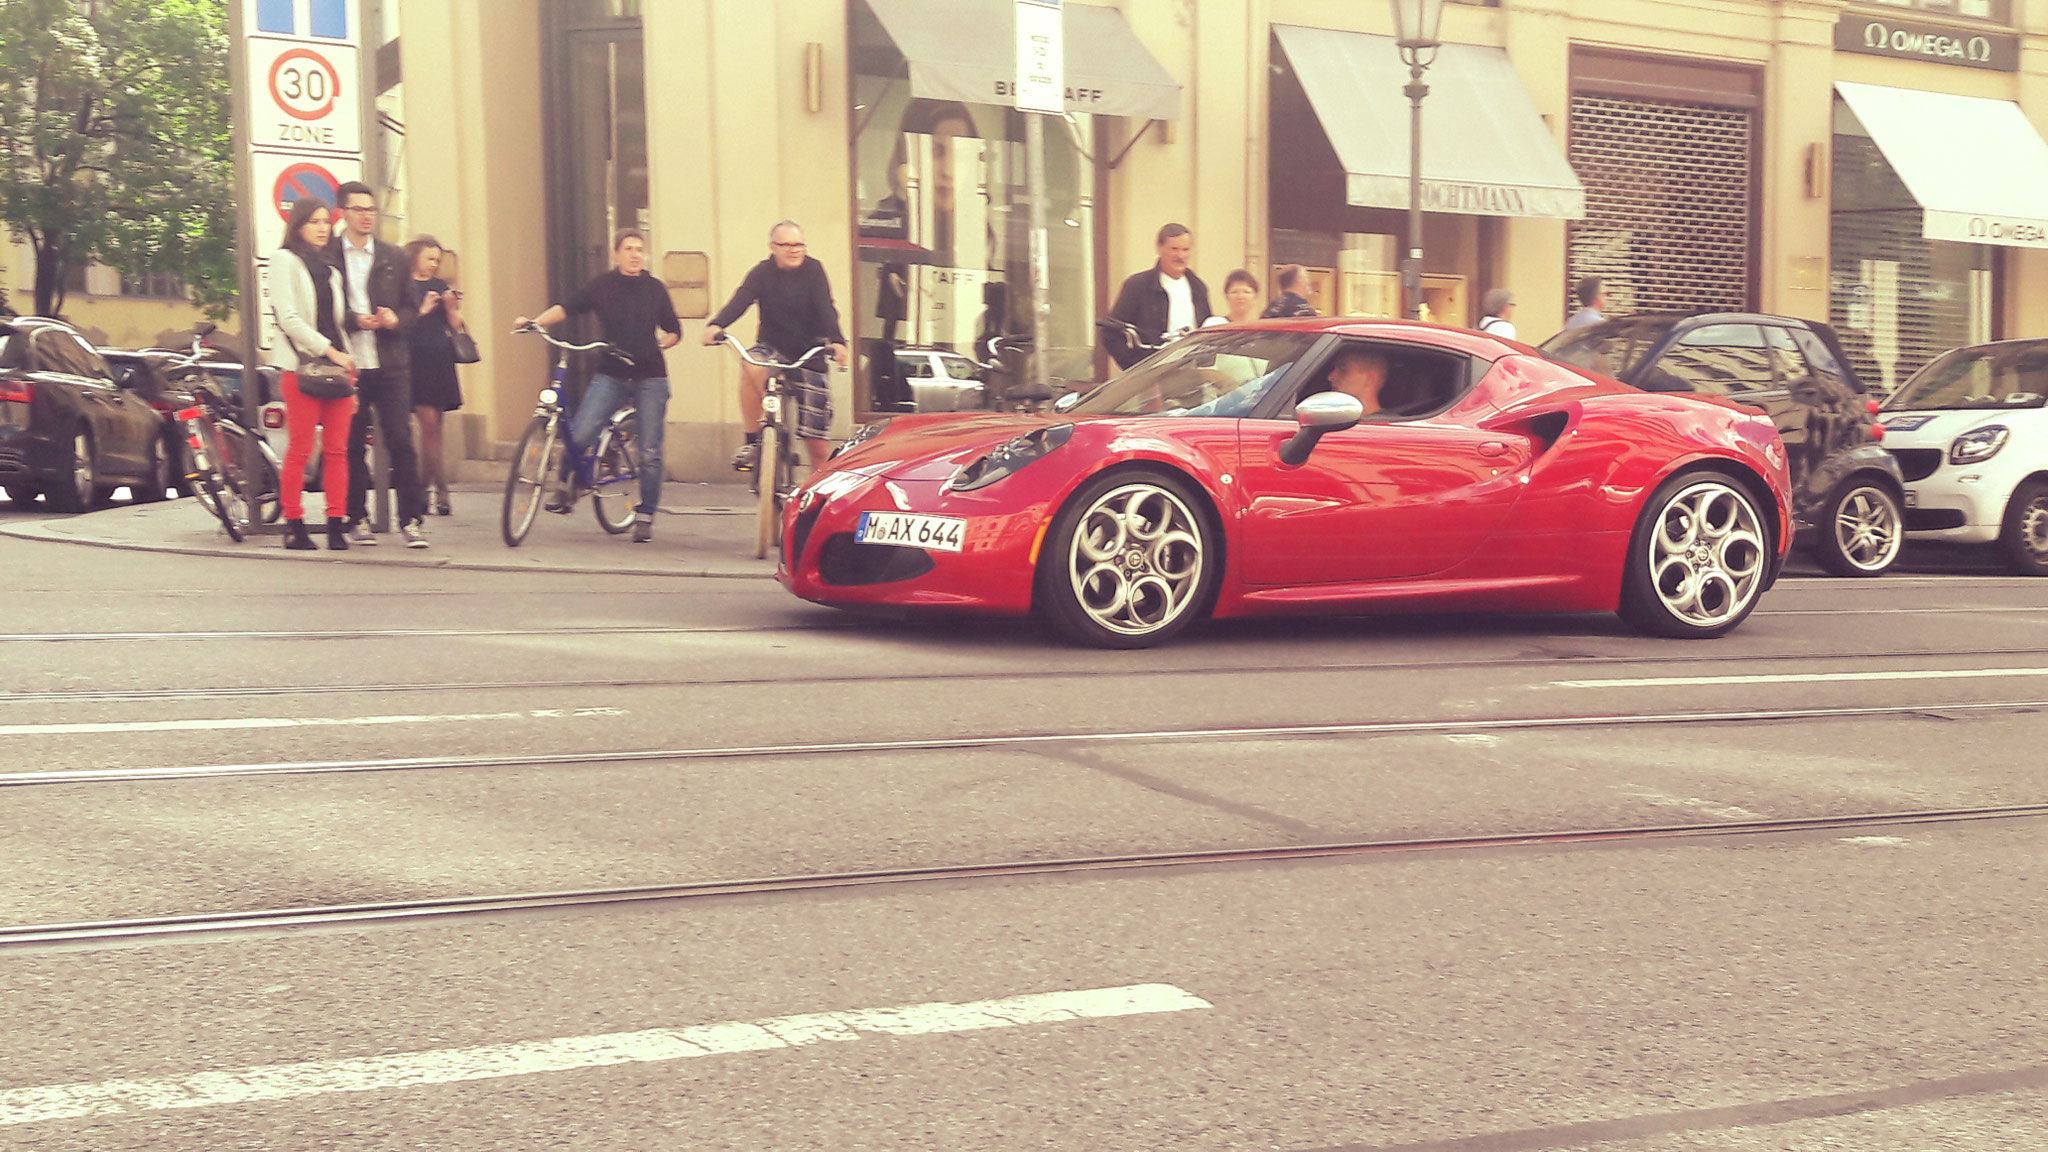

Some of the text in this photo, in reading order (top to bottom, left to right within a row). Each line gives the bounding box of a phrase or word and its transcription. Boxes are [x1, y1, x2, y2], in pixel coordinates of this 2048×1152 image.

[1890, 30, 1965, 59] OMEGA
[282, 67, 325, 101] 30
[277, 123, 335, 144] ZONE
[864, 516, 961, 547] M AX 644
